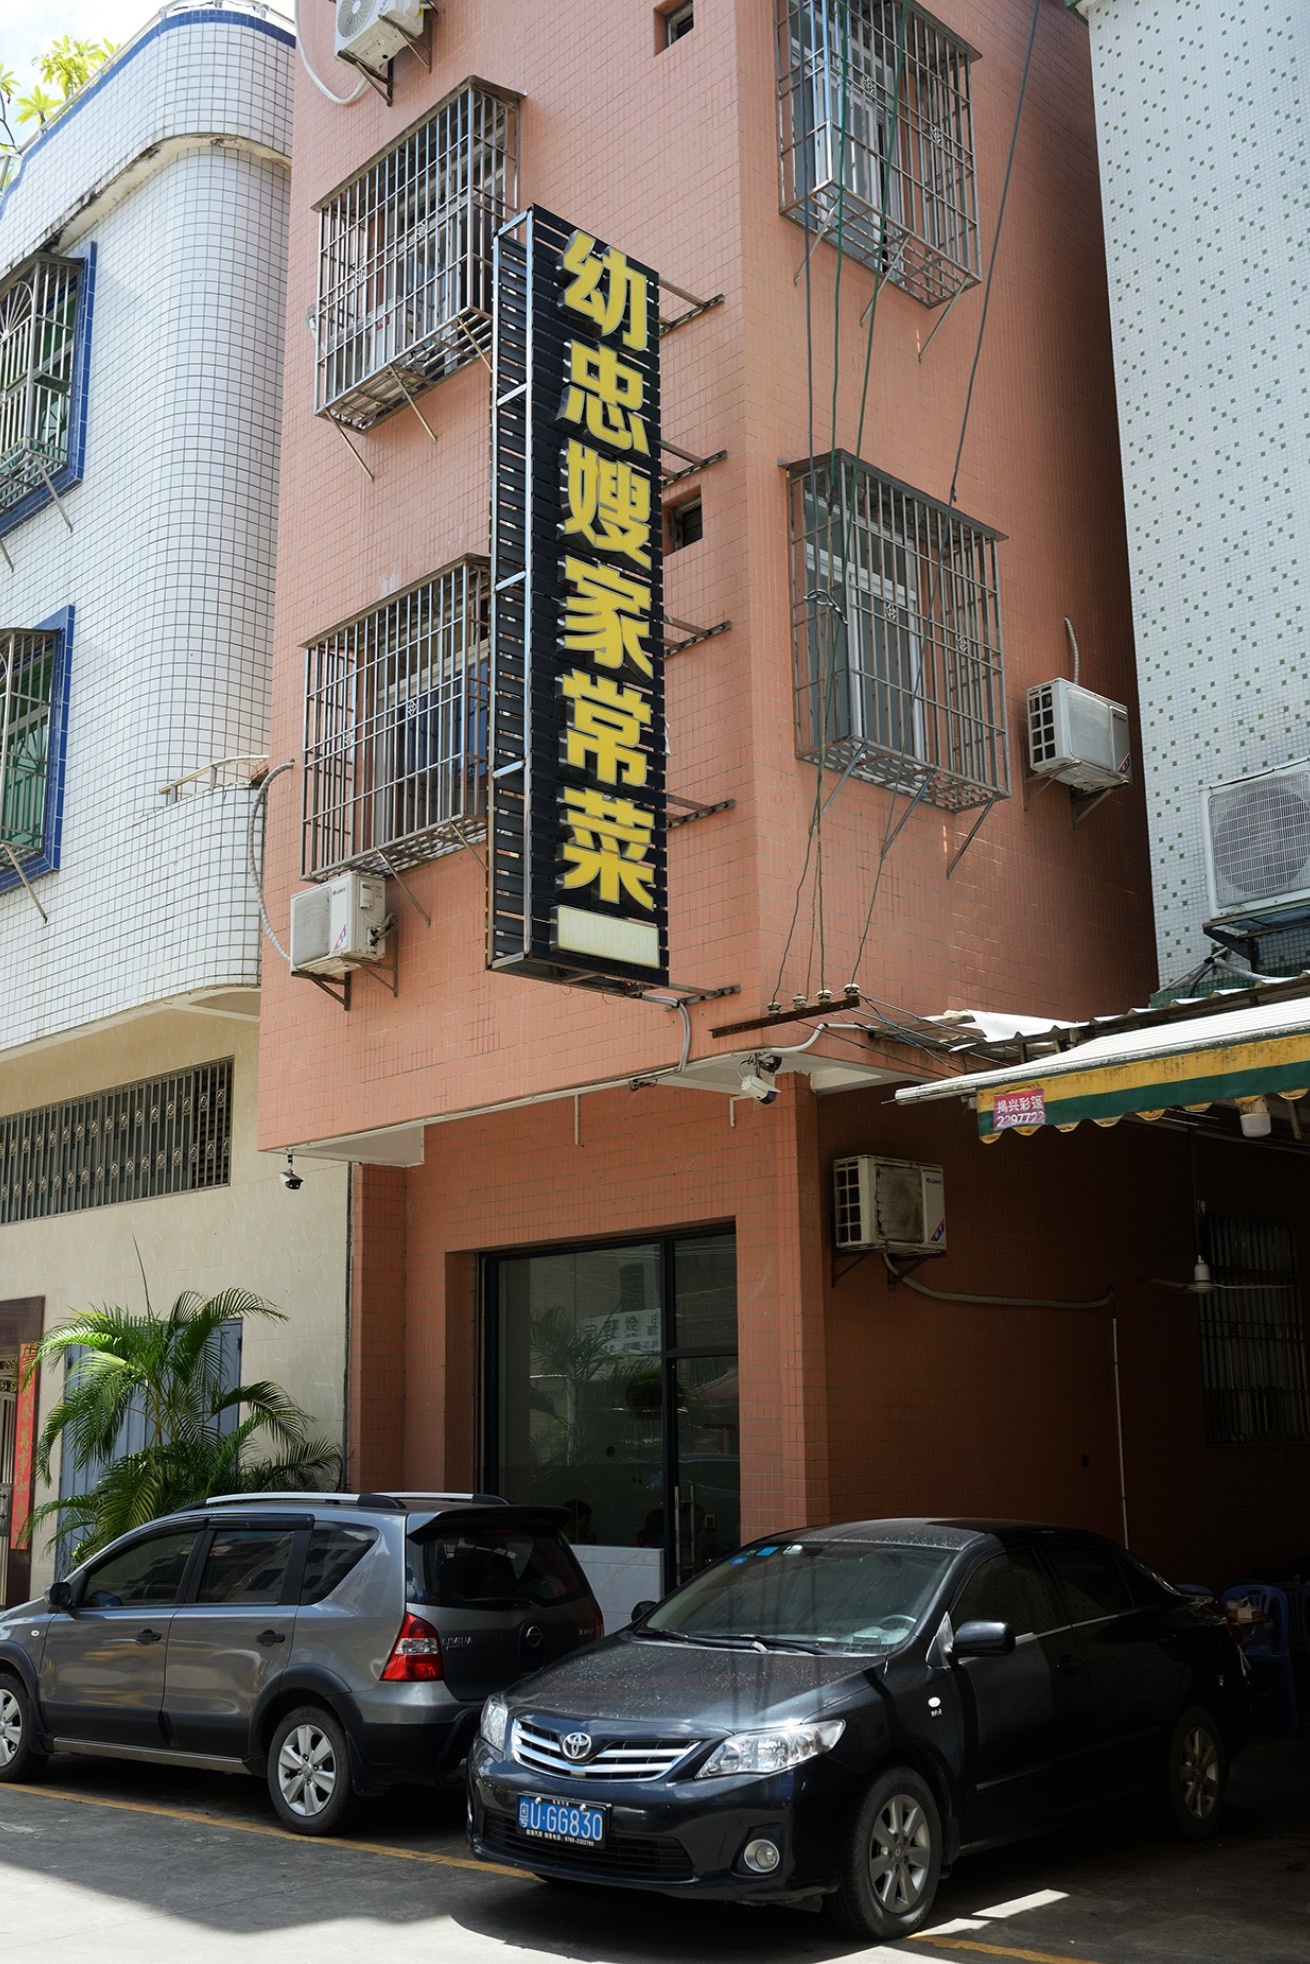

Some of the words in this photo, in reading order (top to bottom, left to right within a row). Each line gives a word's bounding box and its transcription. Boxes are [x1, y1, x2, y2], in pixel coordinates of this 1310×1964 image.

[562, 229, 655, 913] 幼忠嫂家常菜
